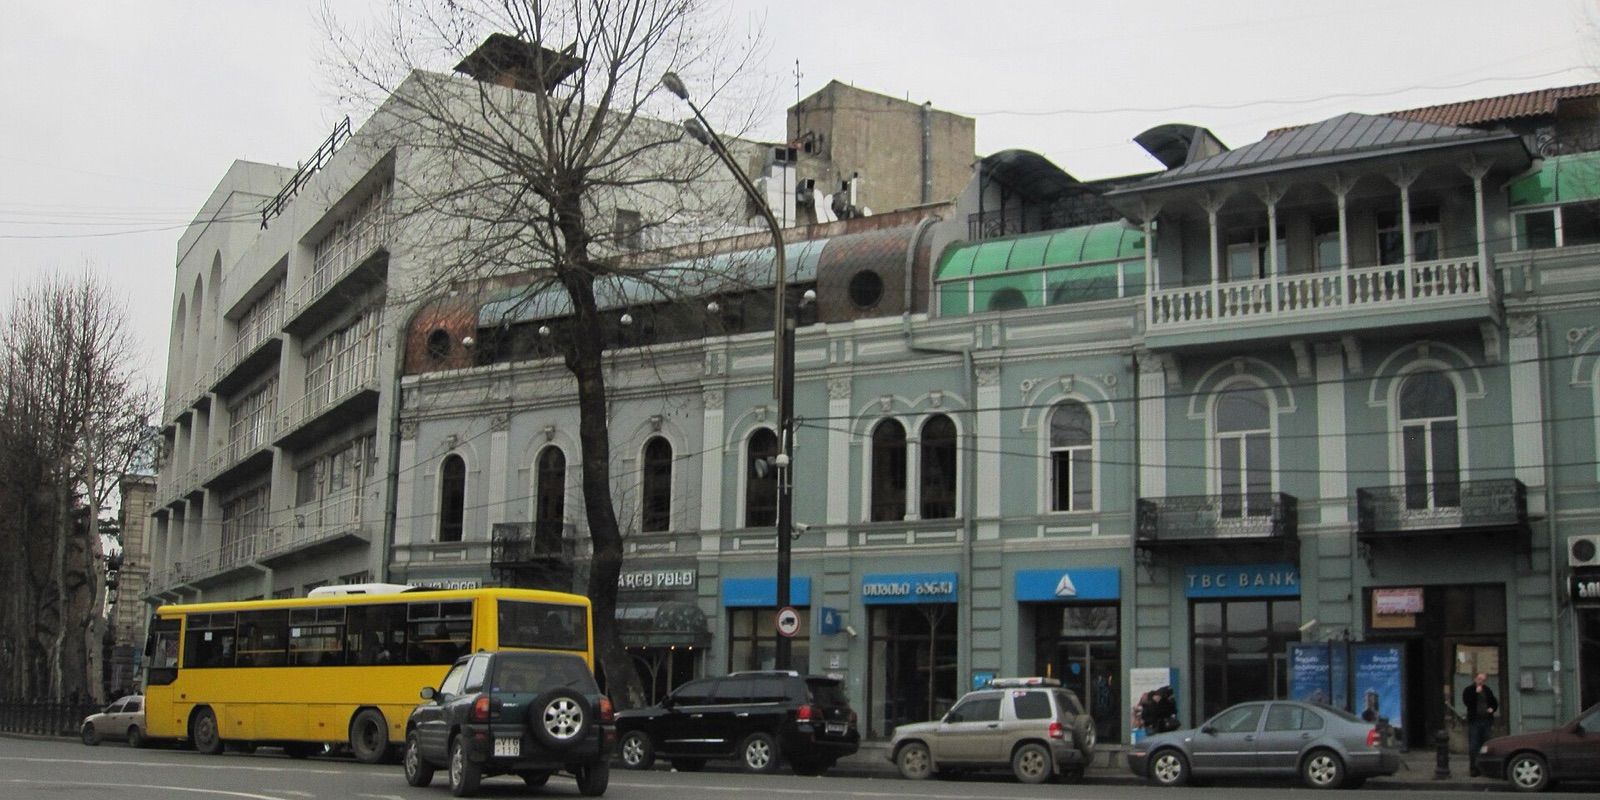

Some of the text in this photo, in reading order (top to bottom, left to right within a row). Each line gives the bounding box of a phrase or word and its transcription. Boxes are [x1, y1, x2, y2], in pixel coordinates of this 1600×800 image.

[617, 572, 692, 588] ARCO POLO
[1187, 572, 1295, 588] TBC BANK
